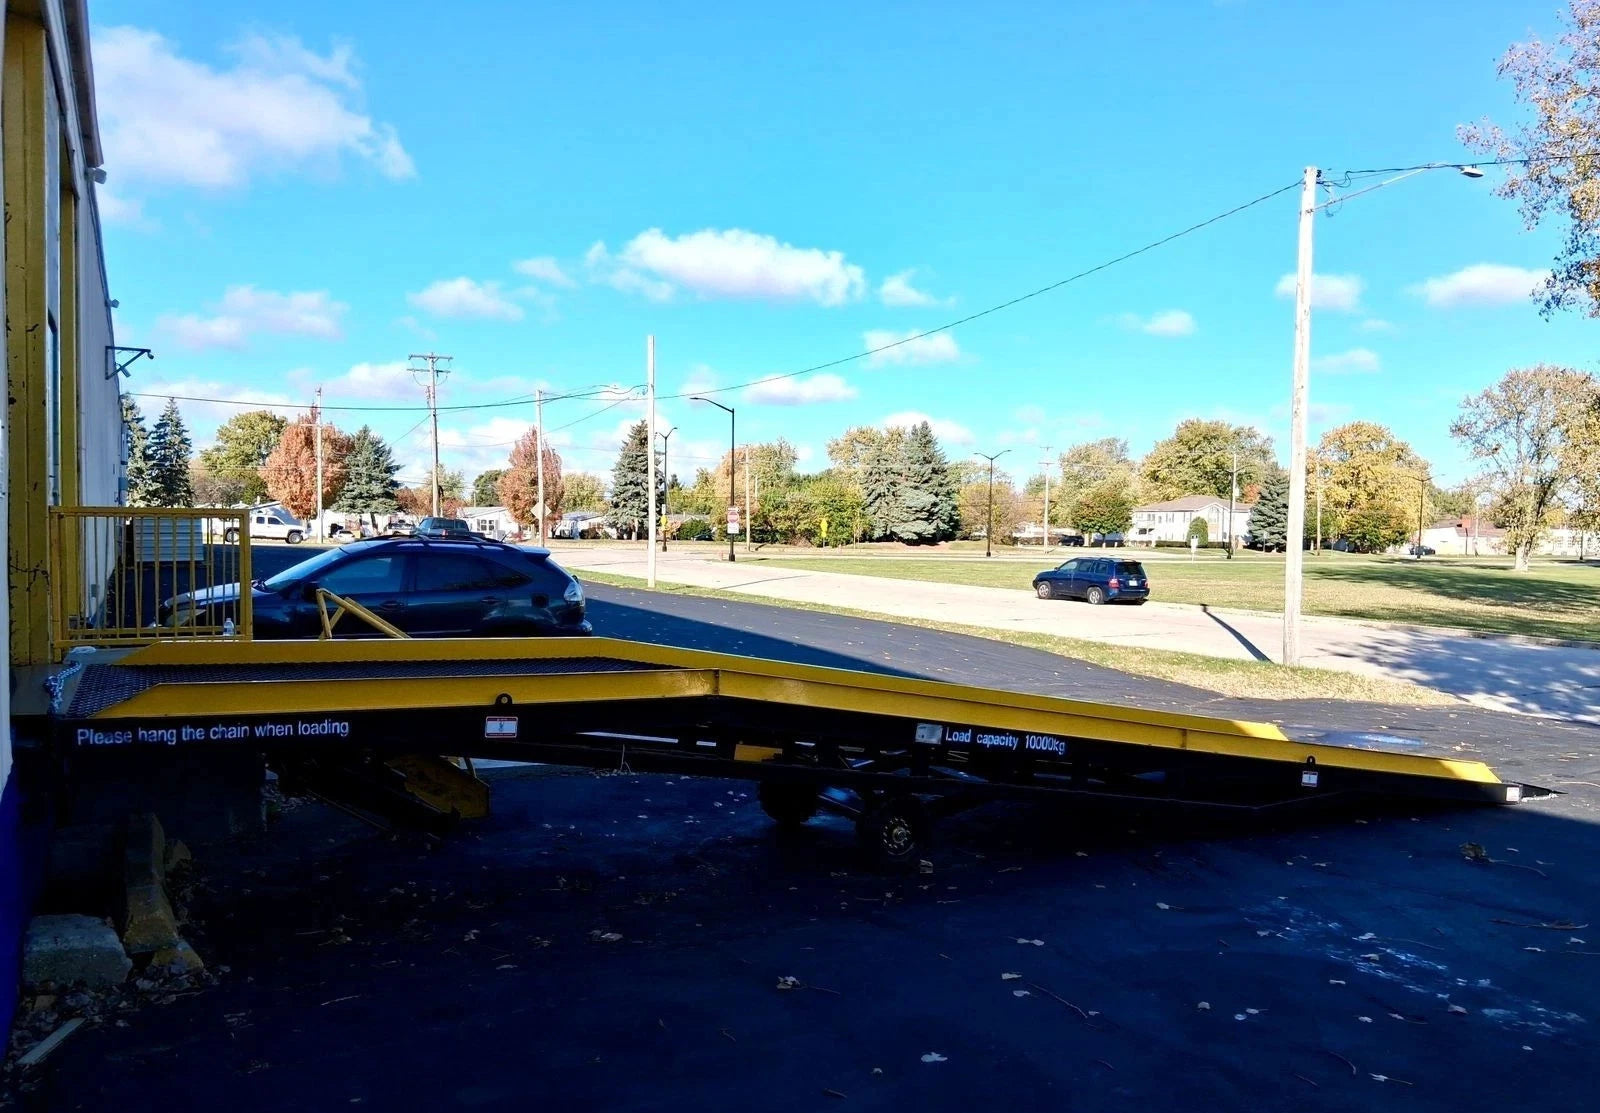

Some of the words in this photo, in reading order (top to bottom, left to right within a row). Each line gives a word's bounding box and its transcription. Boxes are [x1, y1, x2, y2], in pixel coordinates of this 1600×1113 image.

[77, 728, 132, 745] Please
[138, 727, 177, 745] hang
[182, 725, 205, 740] the
[209, 722, 250, 740] chain
[255, 721, 293, 737] when
[298, 720, 349, 737] loading
[946, 727, 971, 742] Load
[976, 732, 1019, 750] capacity
[1025, 735, 1065, 755] 10000kg
